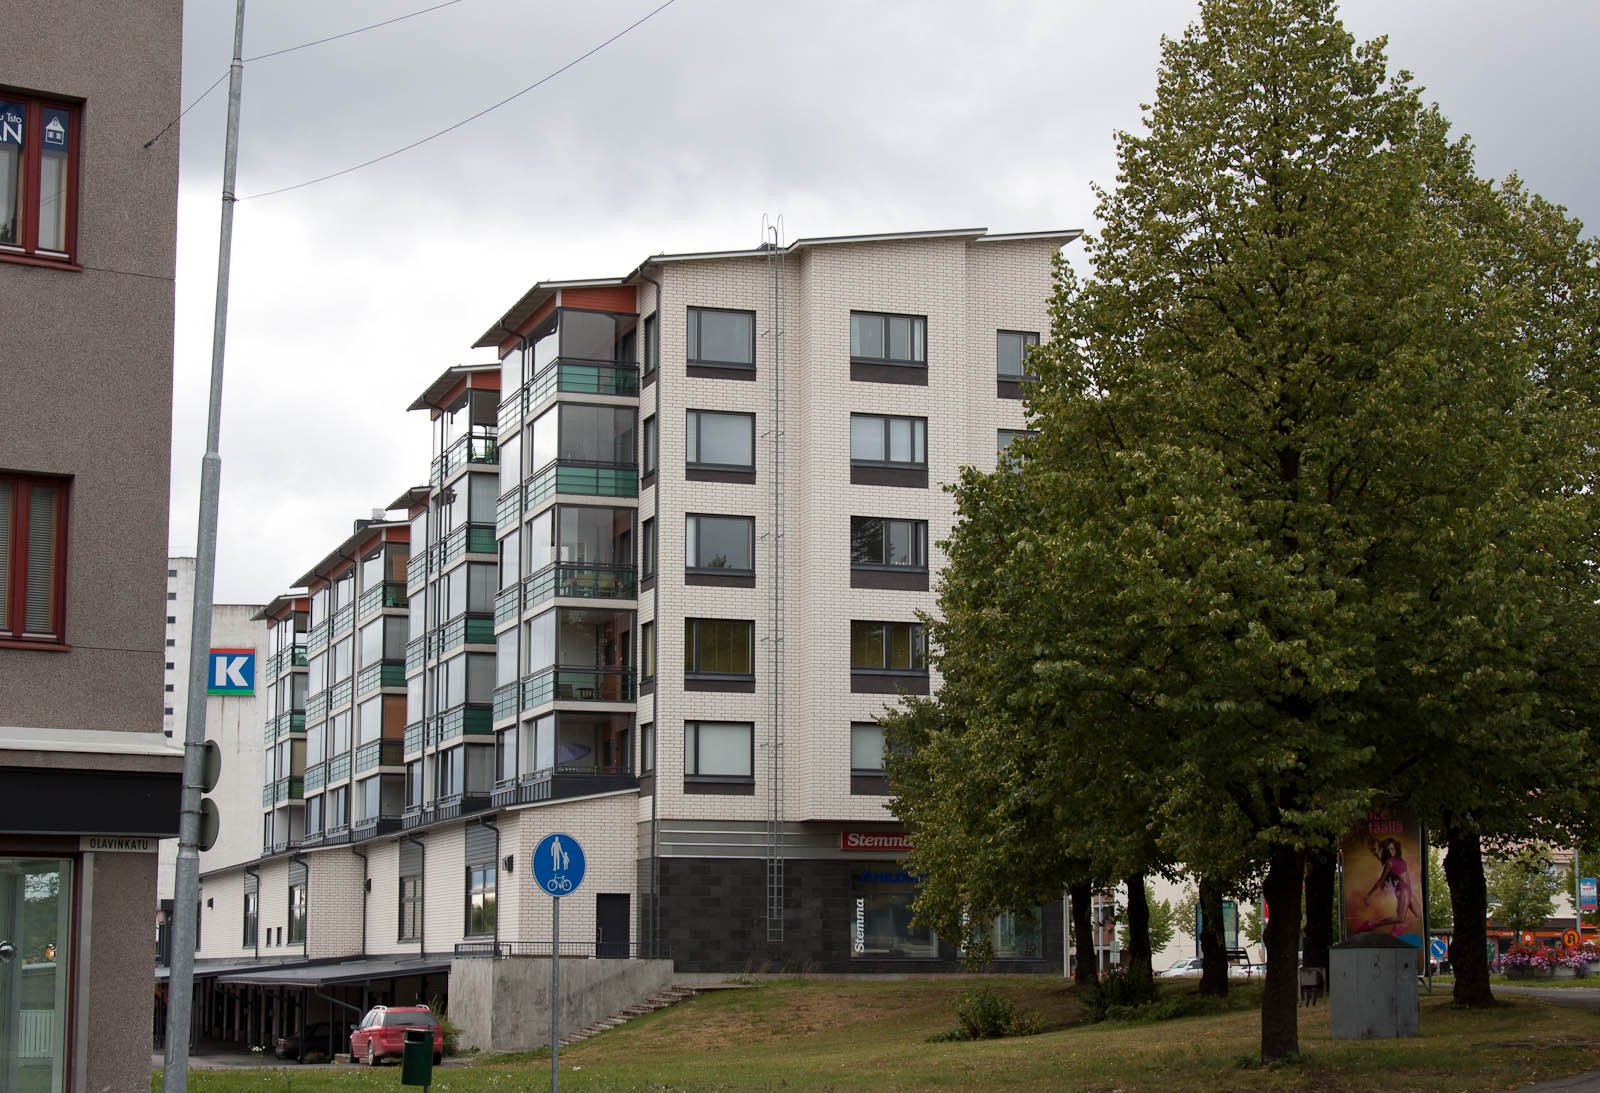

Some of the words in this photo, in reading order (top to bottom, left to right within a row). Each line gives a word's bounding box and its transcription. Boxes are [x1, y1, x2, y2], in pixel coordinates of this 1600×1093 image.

[0, 121, 22, 144] N
[215, 656, 249, 687] K
[89, 838, 148, 850] OLAVINKATU
[855, 897, 865, 952] Stemma
